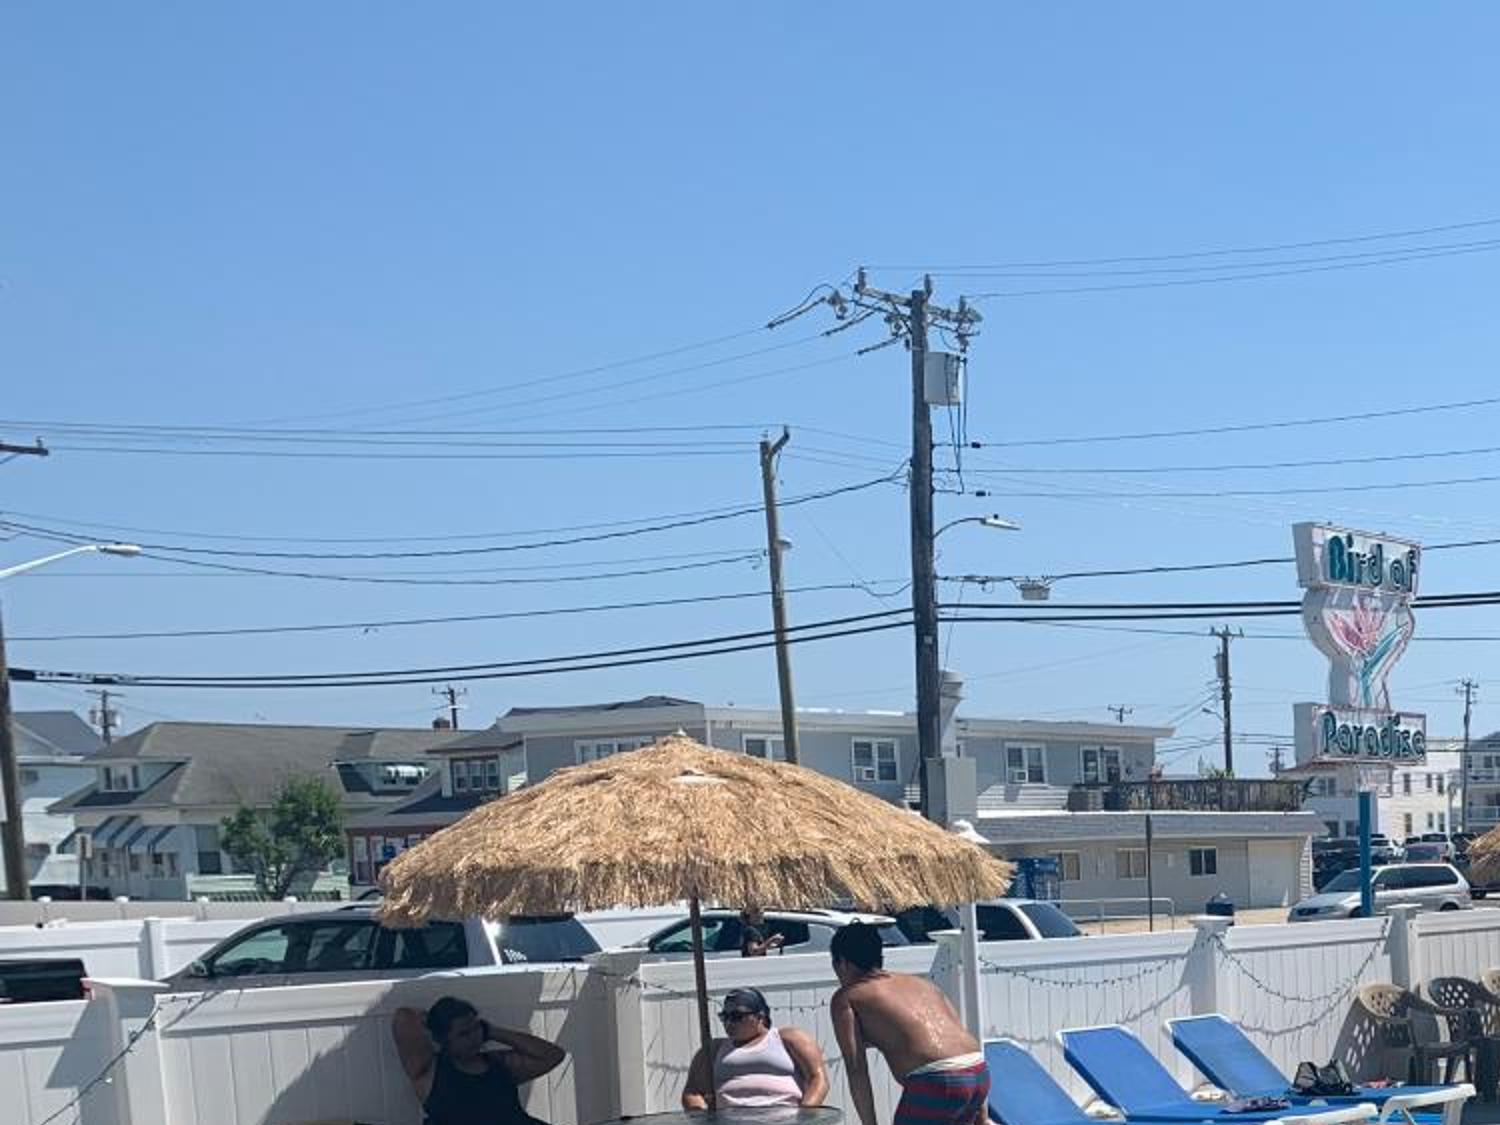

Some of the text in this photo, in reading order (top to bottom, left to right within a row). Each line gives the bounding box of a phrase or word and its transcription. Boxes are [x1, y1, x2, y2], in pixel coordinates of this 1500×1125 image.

[1328, 532, 1416, 592] Bird of
[1322, 710, 1425, 757] Paradise
